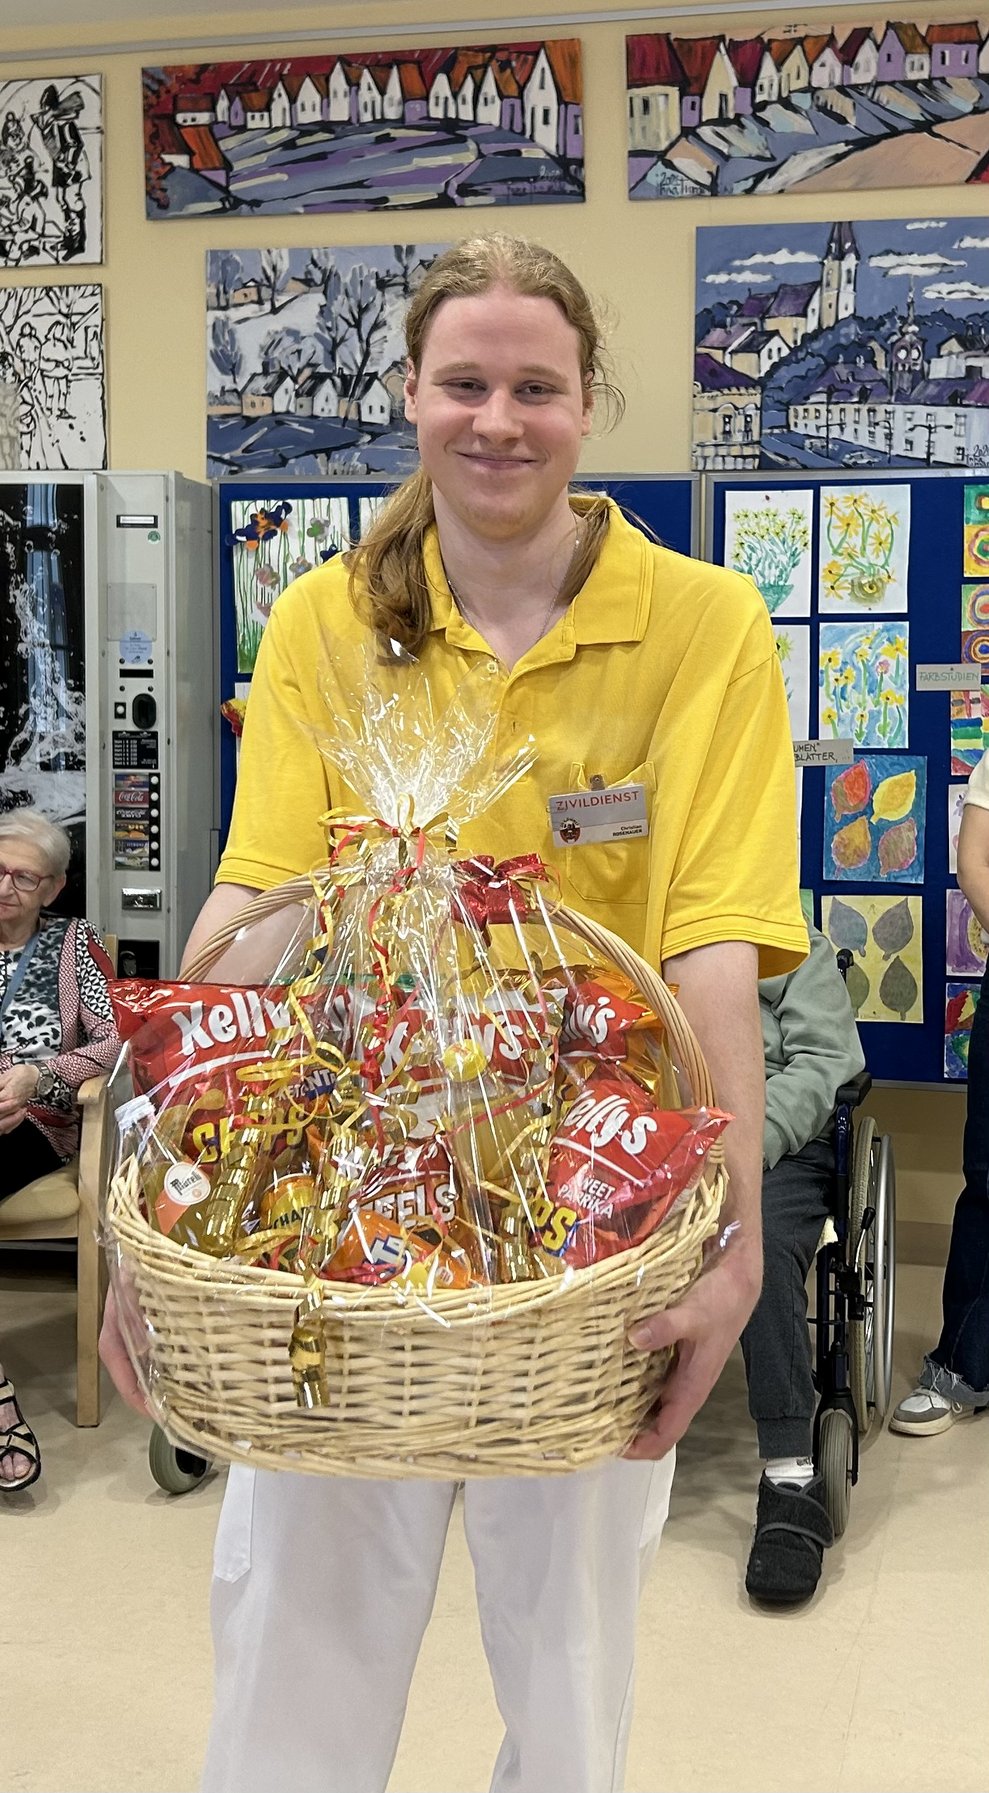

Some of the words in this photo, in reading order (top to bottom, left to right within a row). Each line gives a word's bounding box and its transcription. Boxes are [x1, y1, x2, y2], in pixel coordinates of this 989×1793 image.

[919, 671, 980, 682] FARBSTUDIEN
[793, 742, 820, 752] UMEN"
[556, 791, 639, 811] ZIVILDIENST
[577, 1171, 615, 1200] WEET
